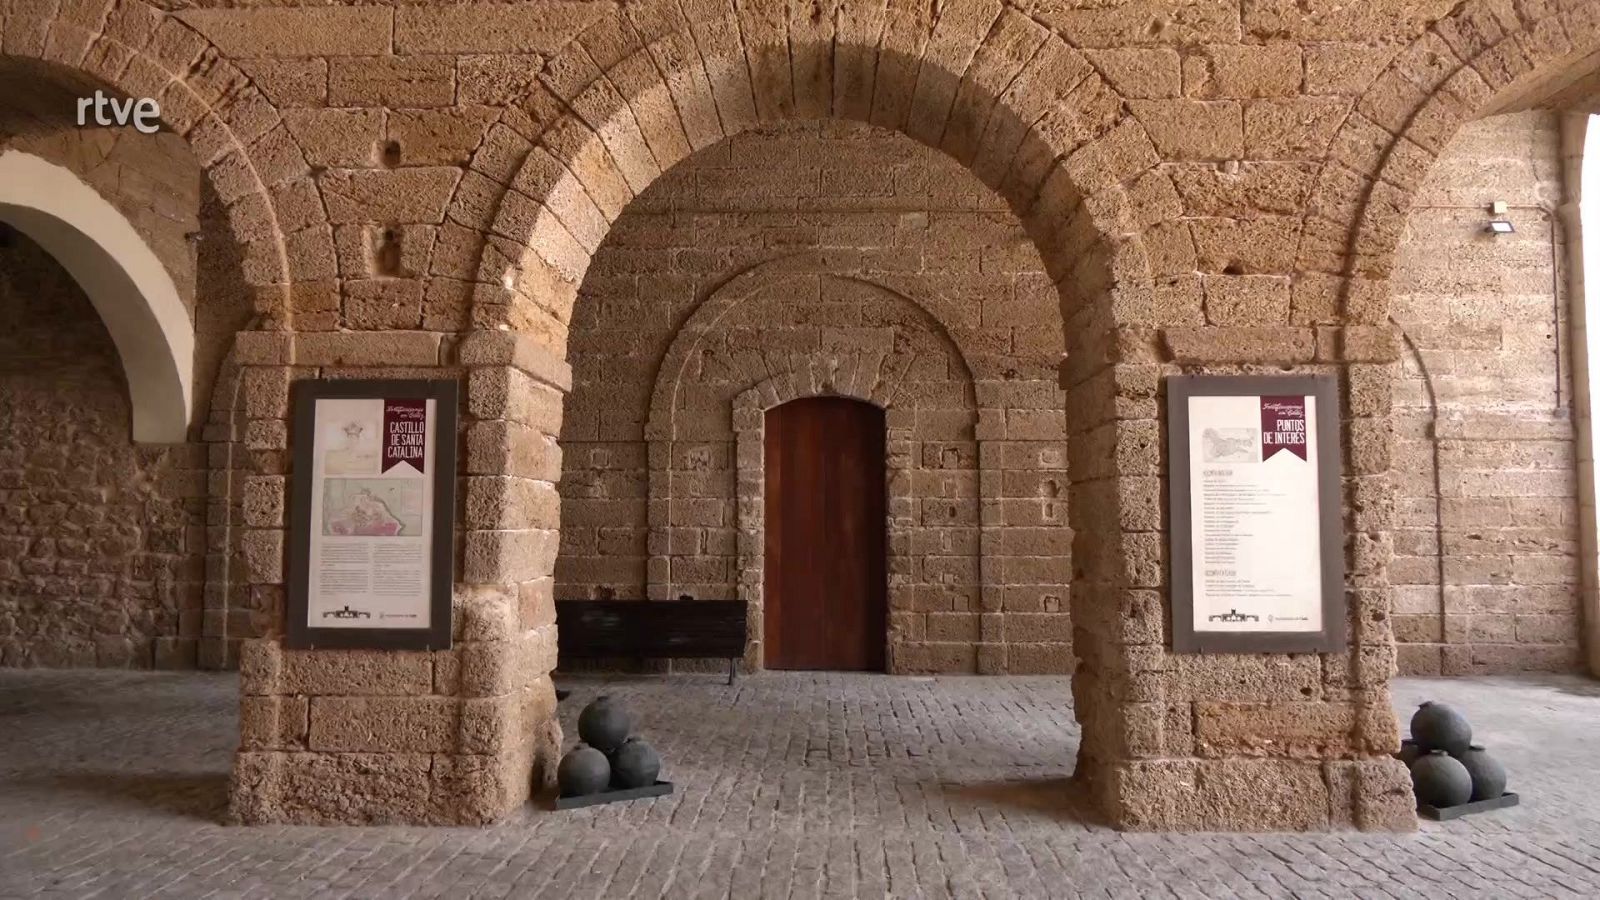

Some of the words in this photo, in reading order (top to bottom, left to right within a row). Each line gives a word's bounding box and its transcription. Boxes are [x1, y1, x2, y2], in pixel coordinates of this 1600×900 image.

[389, 421, 424, 434] CASTILLO
[1276, 419, 1304, 431] PUNTOS
[391, 434, 400, 446] DE
[401, 434, 423, 446] SANTA
[1263, 431, 1273, 444] DE
[387, 446, 423, 458] CATALINA
